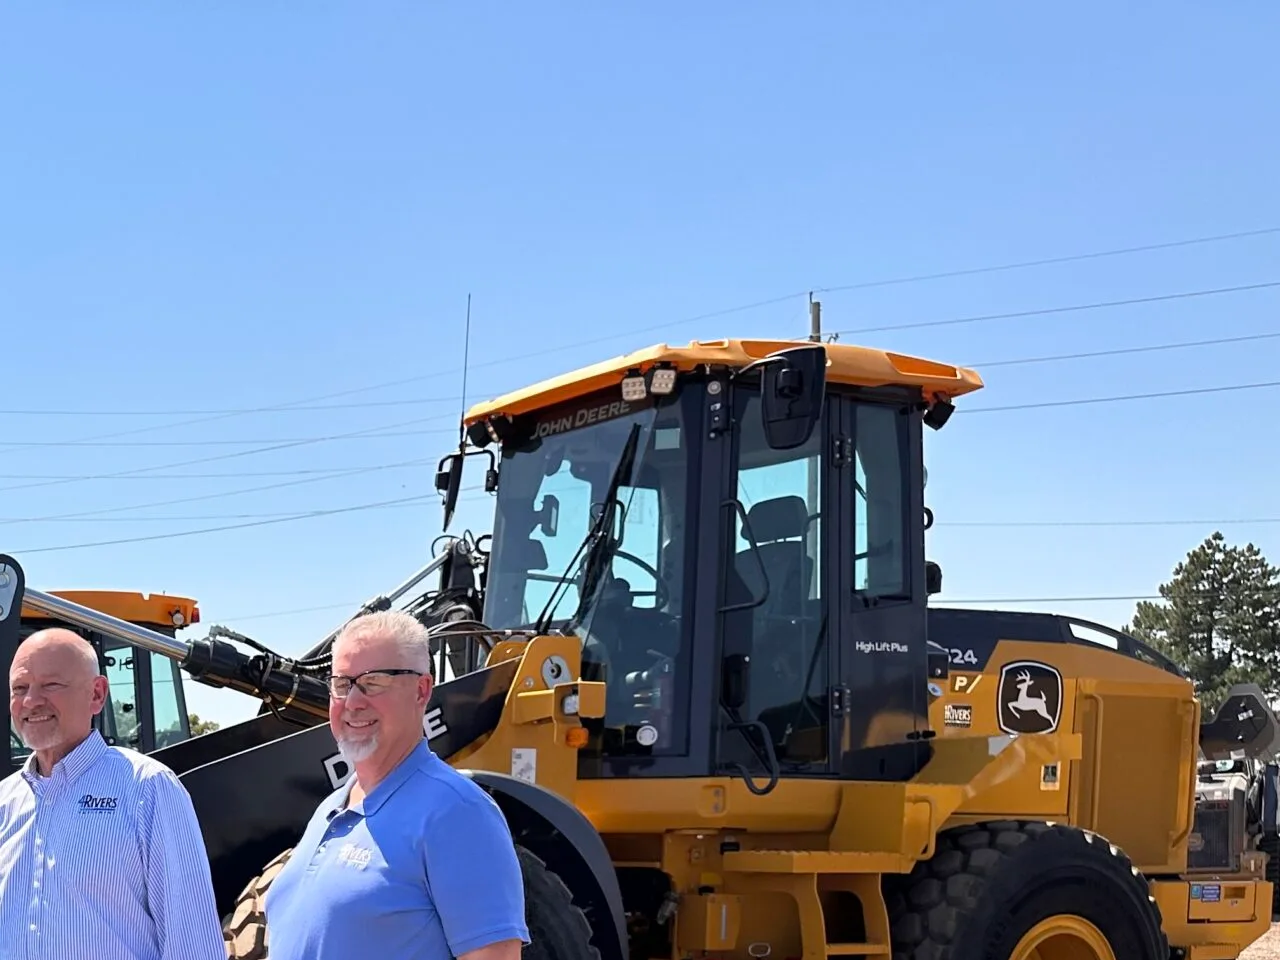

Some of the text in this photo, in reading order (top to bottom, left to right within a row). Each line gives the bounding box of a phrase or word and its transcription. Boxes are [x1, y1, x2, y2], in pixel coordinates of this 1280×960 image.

[529, 401, 631, 440] JOHN DEERE
[855, 641, 909, 653] High Lift Plus
